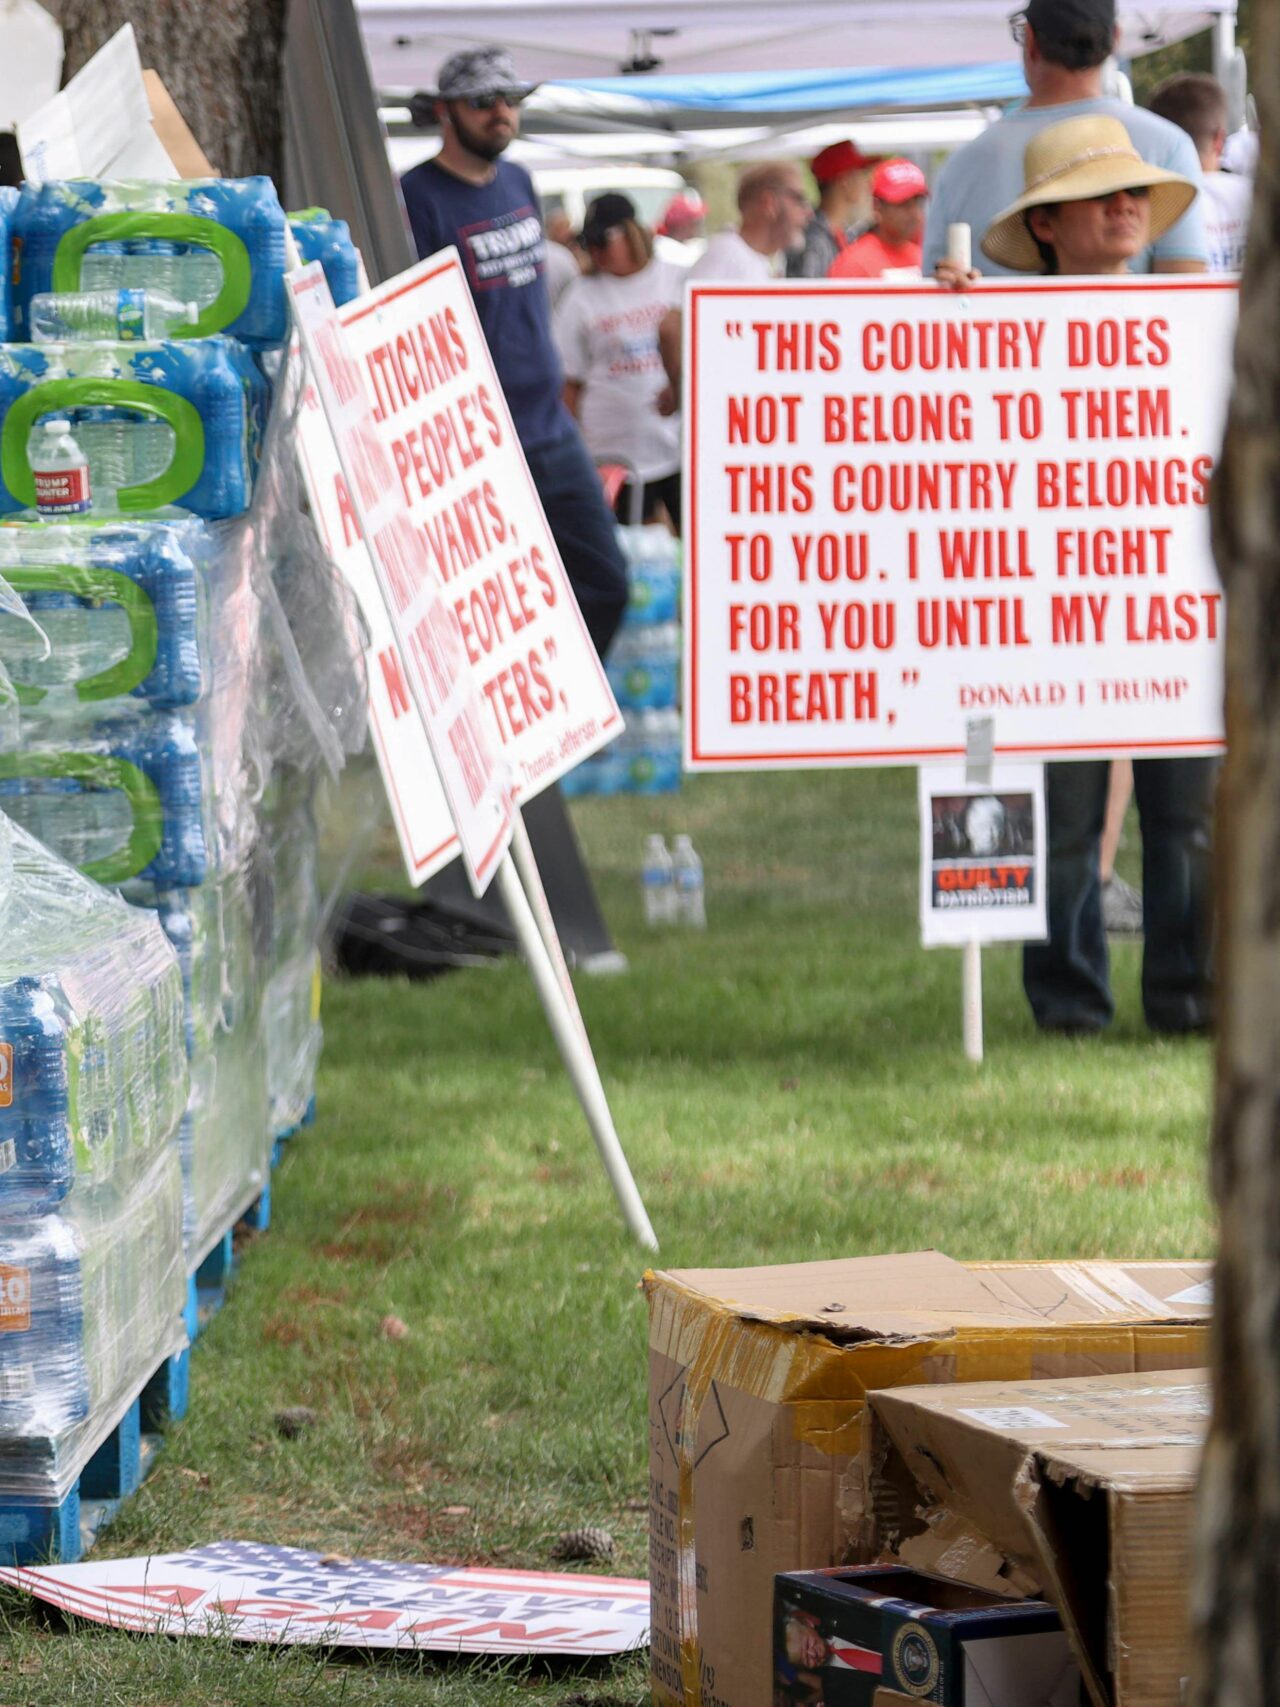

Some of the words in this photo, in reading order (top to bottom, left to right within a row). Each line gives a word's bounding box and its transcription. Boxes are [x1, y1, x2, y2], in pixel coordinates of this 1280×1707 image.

[467, 216, 541, 260] TRUMP
[365, 306, 468, 423] ITICIANS
[861, 321, 1046, 372] COUNTRY
[1067, 319, 1170, 368] DOES
[728, 395, 801, 444] NOT
[824, 394, 973, 443] BELONG
[992, 393, 1042, 440] TO
[1060, 389, 1188, 439] THEM.
[391, 383, 502, 507] PEOPLE'S
[725, 464, 813, 513] THIS
[833, 462, 1017, 512] COUNTRY
[1037, 457, 1214, 508] BELONGS
[417, 479, 519, 583] VANTS,
[725, 534, 772, 582] TO
[791, 533, 886, 582] YOU.
[907, 531, 918, 580] I
[939, 530, 1034, 579] WILL
[1056, 528, 1172, 577] FIGHT
[729, 603, 800, 651] FOR
[818, 602, 895, 650] YOU
[918, 598, 1030, 648] UNTIL
[1051, 594, 1109, 643] MY
[1126, 593, 1221, 641] LAST
[482, 636, 568, 744] TERS,"
[958, 680, 1066, 706] DONALD
[1097, 676, 1189, 702] TRUMP
[936, 887, 1030, 908] PATRIOTISM
[937, 866, 1030, 889] GUILTY
[91, 1584, 623, 1643] AGAIN!
[163, 1558, 397, 1593] MAKE
[408, 1586, 650, 1616] NEVAD
[255, 1586, 572, 1621] GREAT
